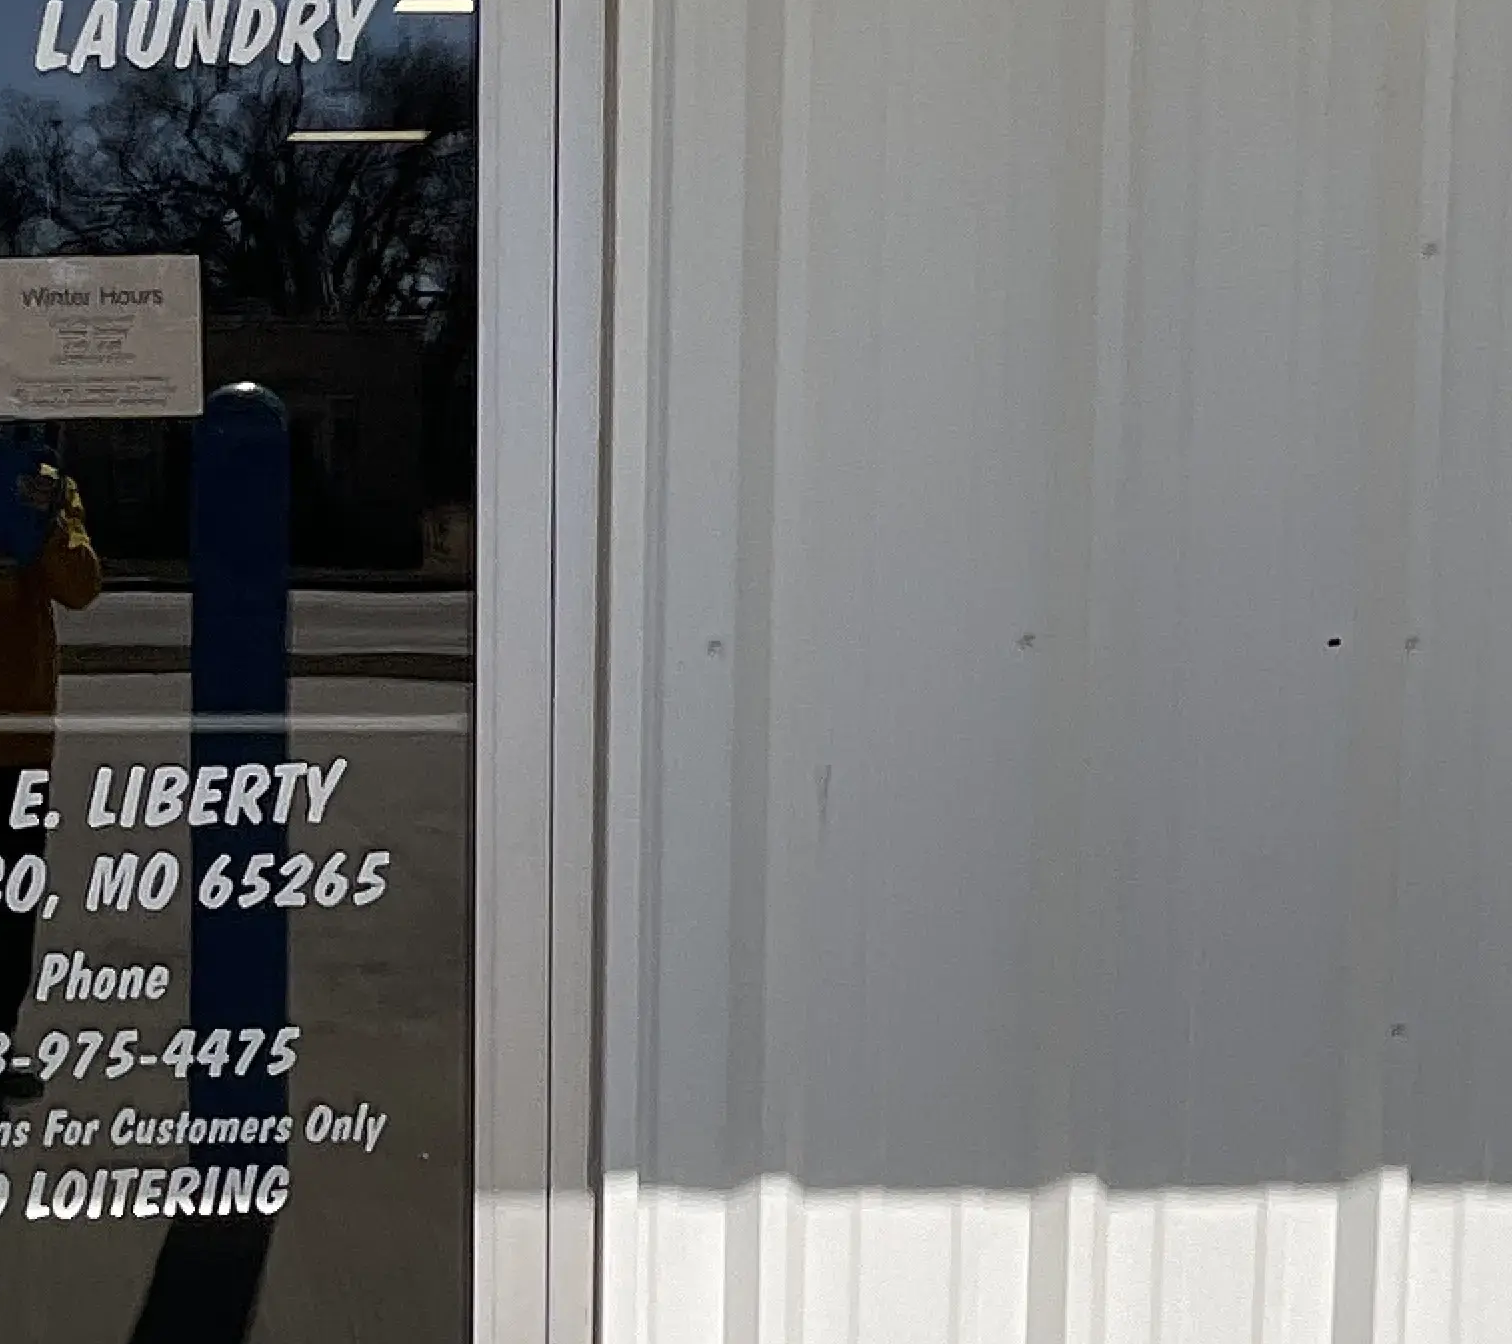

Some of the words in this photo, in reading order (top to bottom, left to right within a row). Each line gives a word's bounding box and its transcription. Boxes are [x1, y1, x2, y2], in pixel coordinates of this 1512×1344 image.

[21, 286, 91, 307] Winter
[99, 286, 164, 307] Hours
[8, 769, 61, 830] E.
[86, 758, 348, 828] LIBERTY
[86, 852, 180, 912] MO
[198, 851, 391, 910] 65265
[36, 950, 170, 1002] Phone
[42, 1109, 100, 1148] For
[110, 1108, 294, 1146] Customers
[305, 1102, 389, 1152] Only
[24, 1164, 290, 1220] LOITERING
